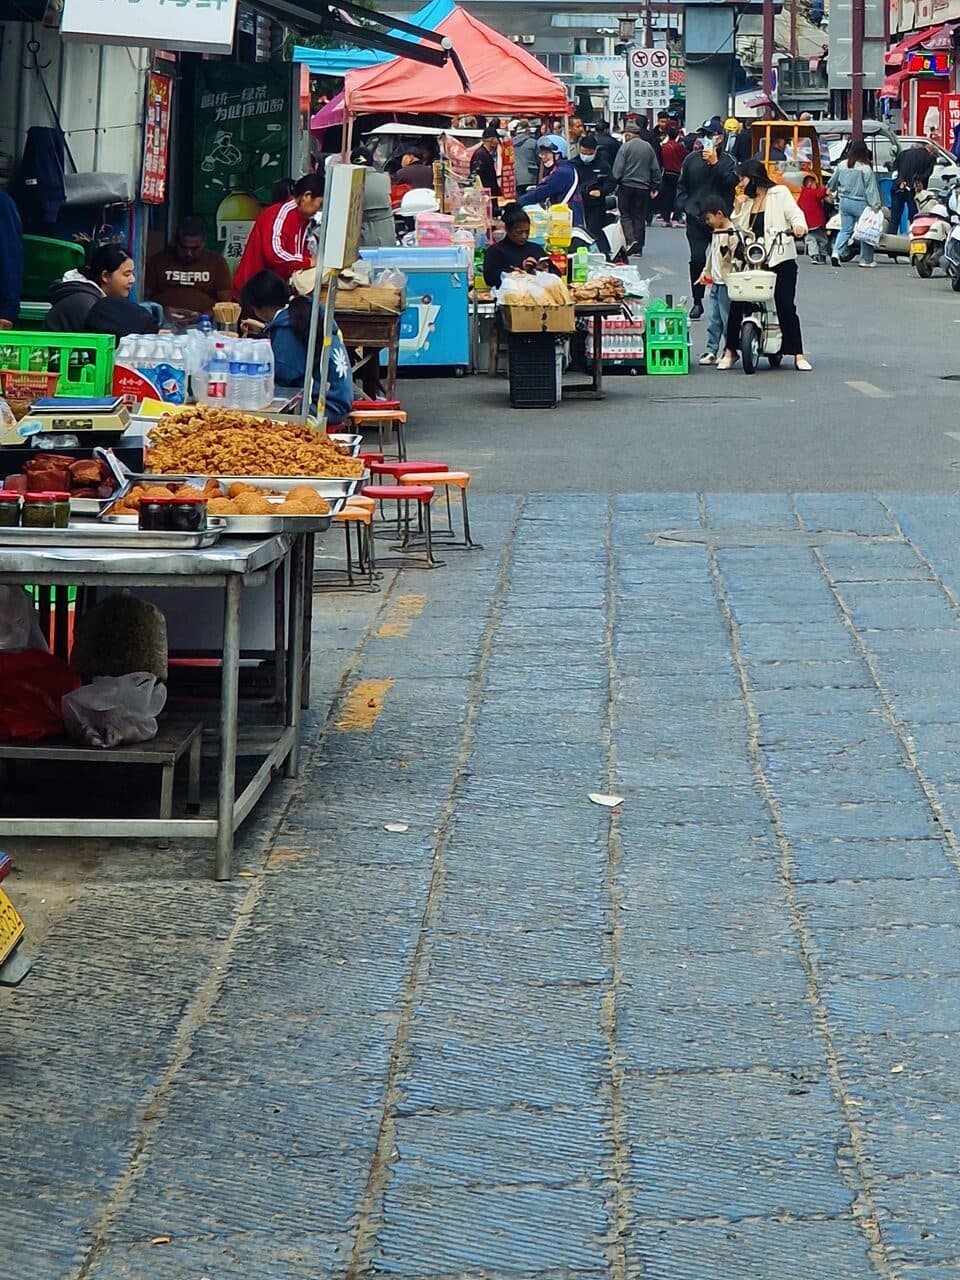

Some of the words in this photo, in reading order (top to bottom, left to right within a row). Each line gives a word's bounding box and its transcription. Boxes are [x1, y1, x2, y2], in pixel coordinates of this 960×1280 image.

[634, 70, 667, 78] 前方路口
[634, 98, 667, 107] 左右转
[949, 100, 959, 109] BE
[214, 99, 285, 122] 为健康加酚
